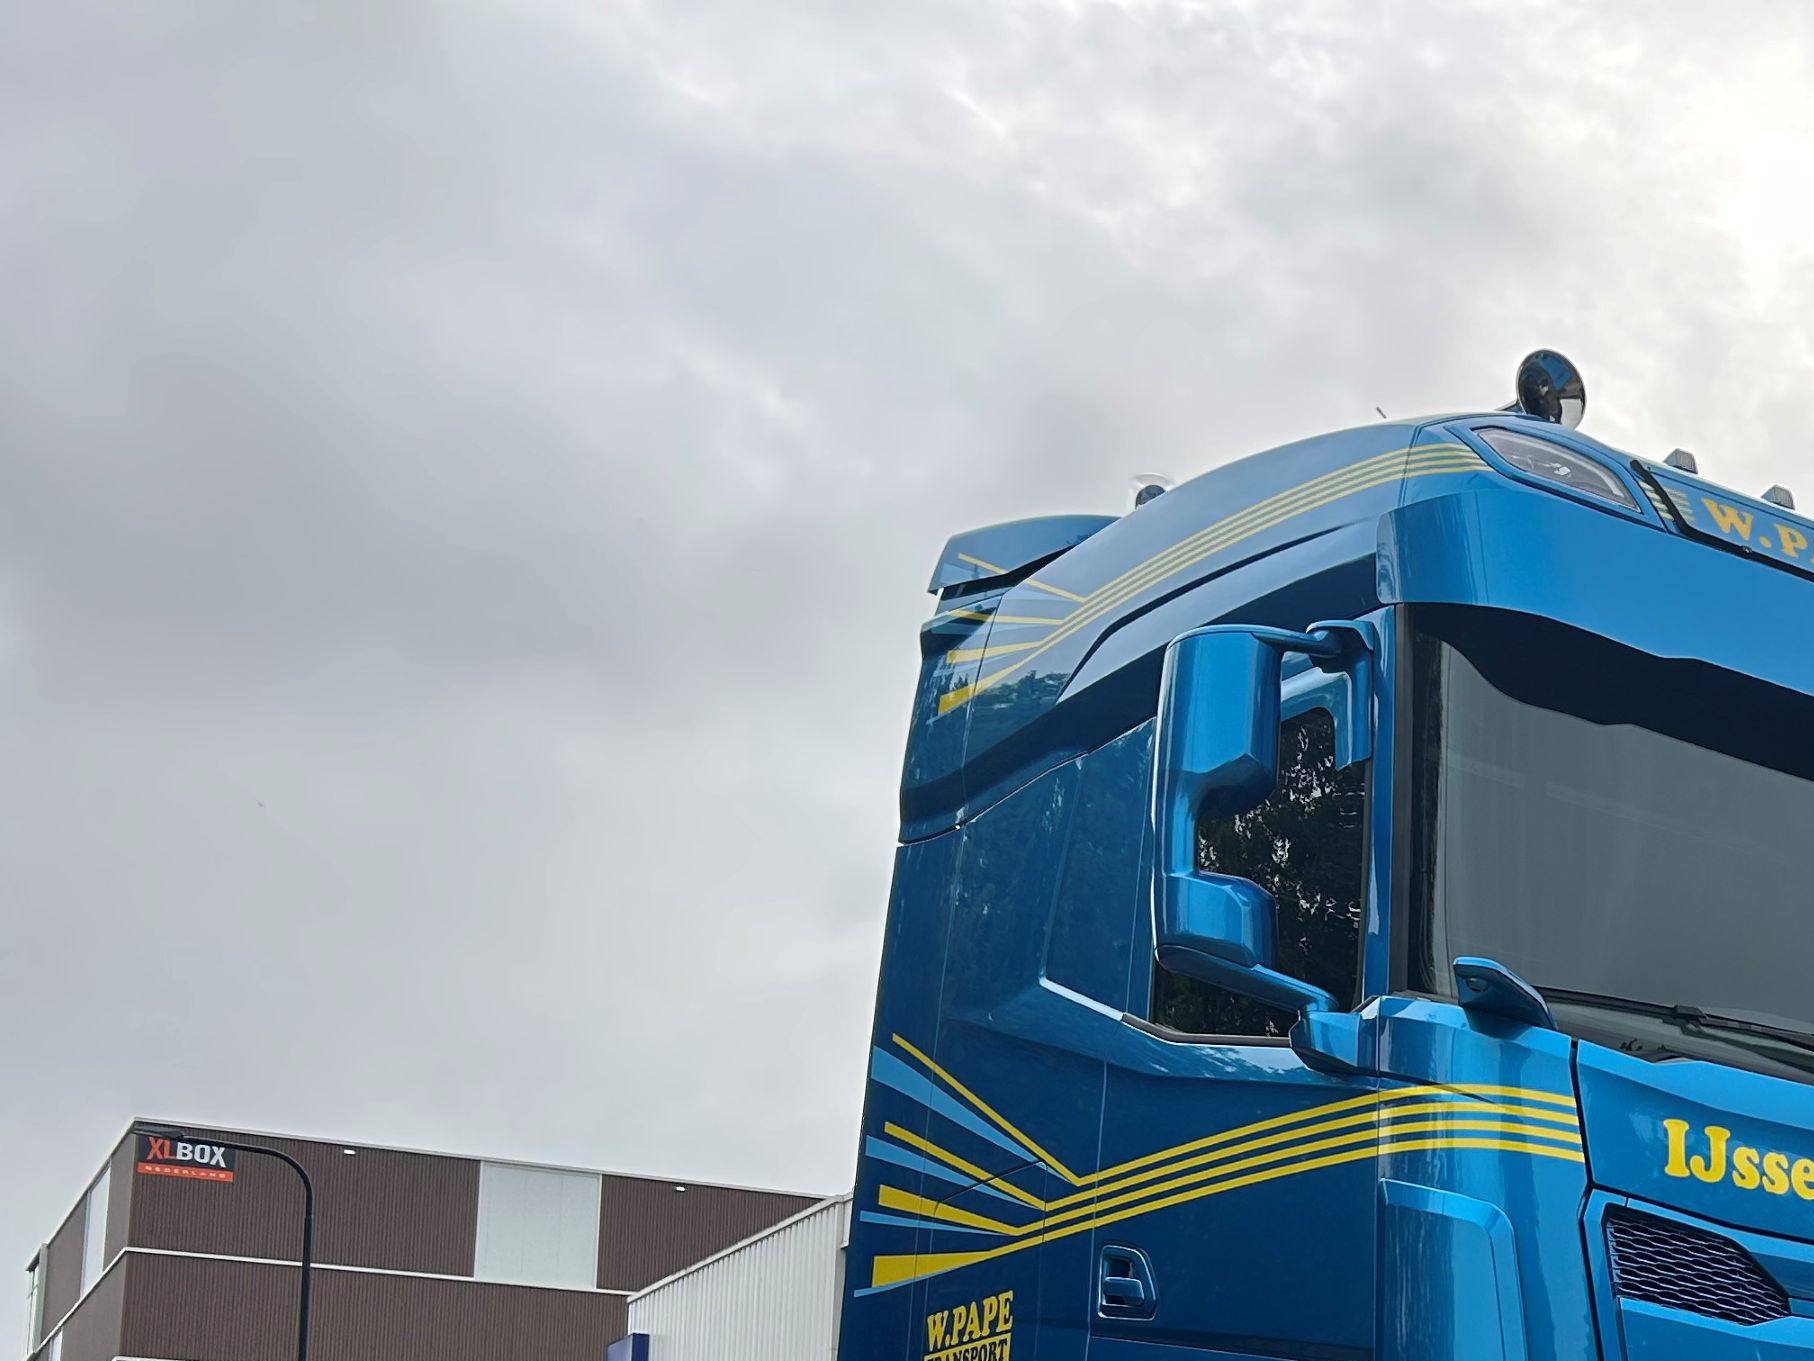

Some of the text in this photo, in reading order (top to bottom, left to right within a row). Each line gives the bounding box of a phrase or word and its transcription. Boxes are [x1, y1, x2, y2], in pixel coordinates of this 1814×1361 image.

[147, 1137, 227, 1168] XLBOX
[145, 1165, 226, 1178] NEDERLAND
[927, 1290, 1014, 1352] W.PAPE
